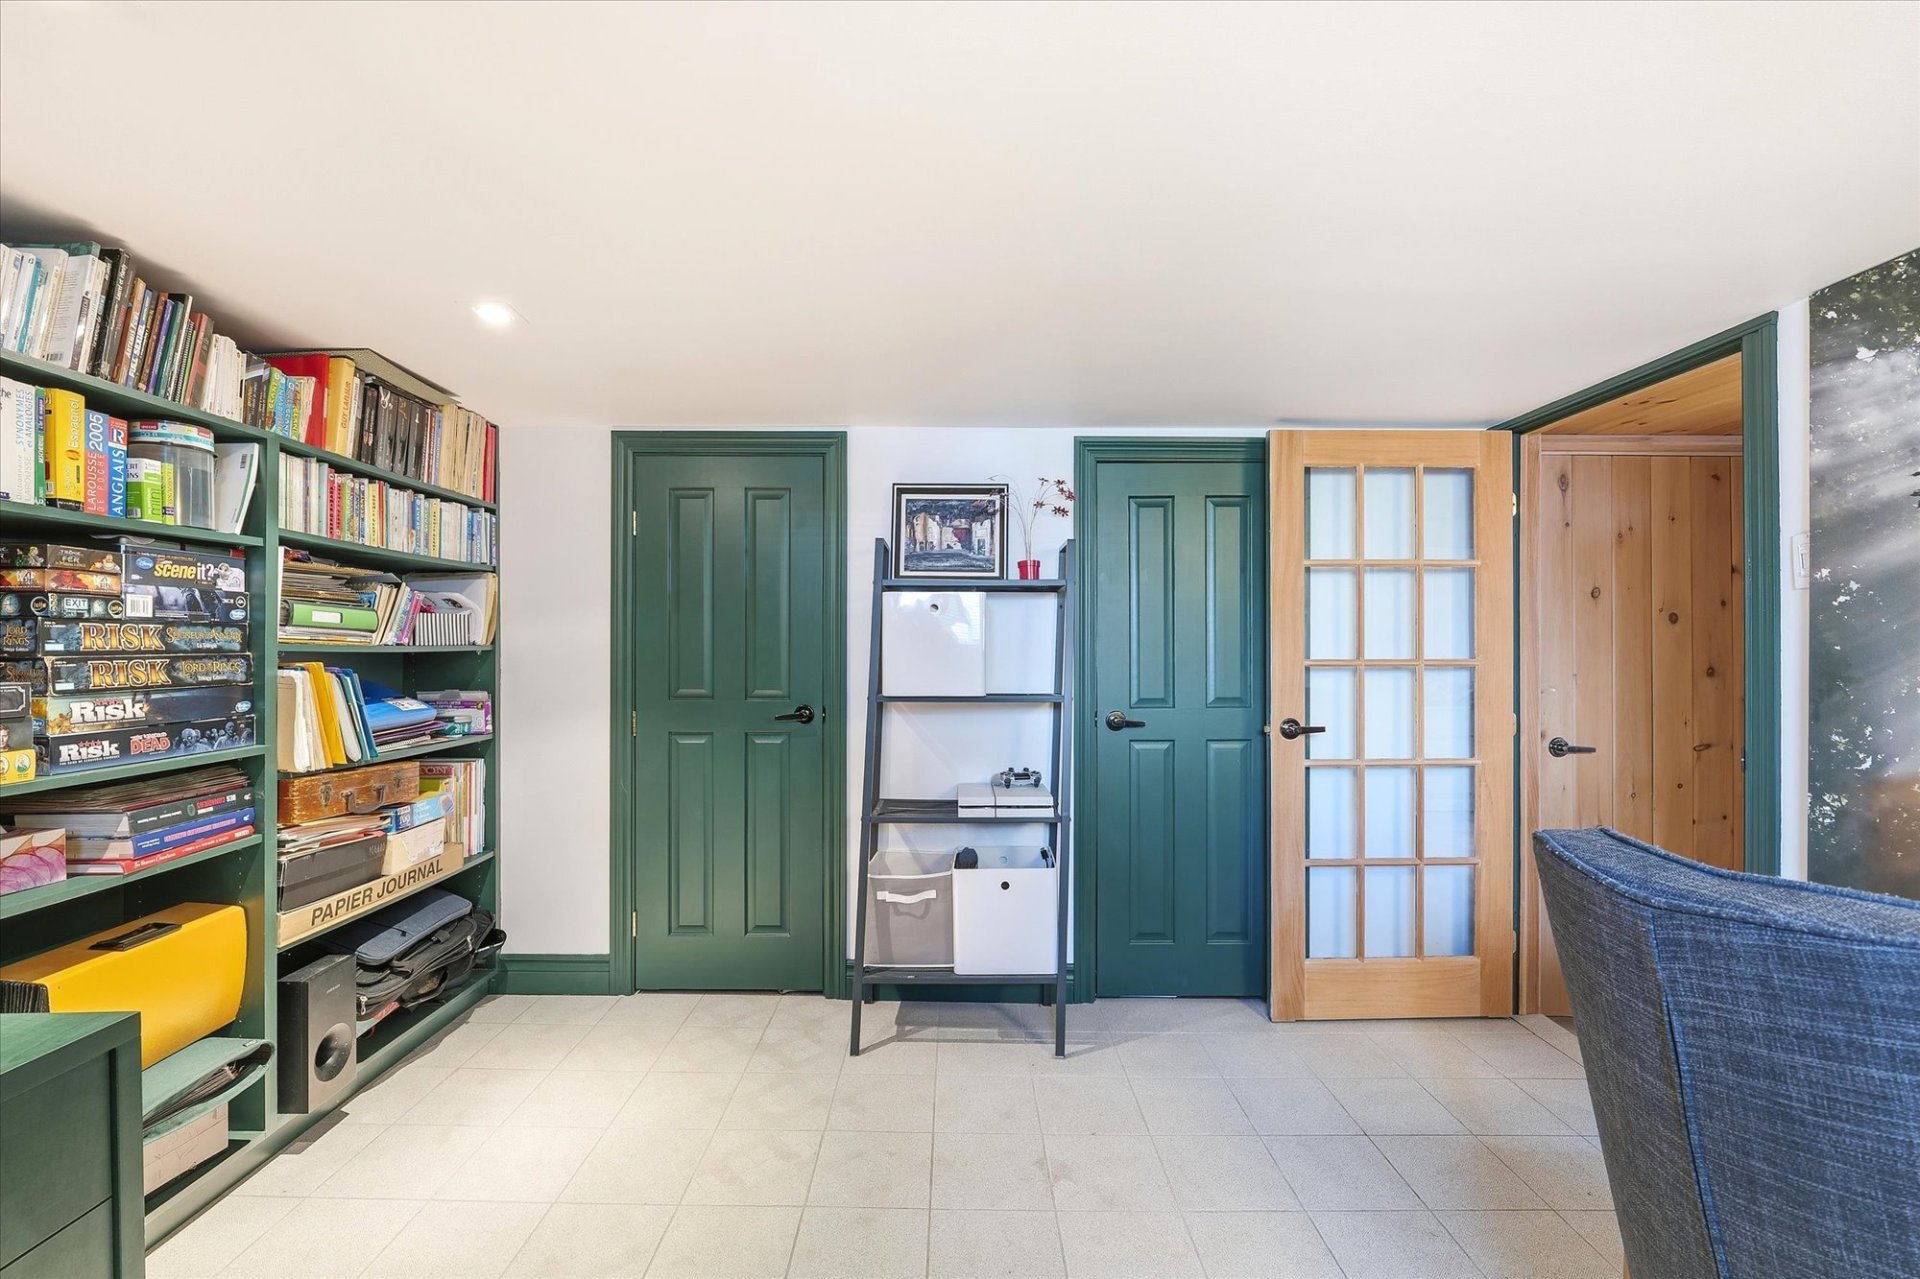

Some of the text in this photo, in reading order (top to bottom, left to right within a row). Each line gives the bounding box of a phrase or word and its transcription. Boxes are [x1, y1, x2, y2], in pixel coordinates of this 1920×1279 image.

[16, 388, 25, 447] SYNONYMES
[25, 390, 33, 440] ANALOGIES
[68, 400, 79, 448] Espagnol
[340, 412, 348, 429] GUY
[88, 413, 104, 511] LAROUSSE 2005
[112, 449, 125, 515] ANGLAIS
[97, 499, 104, 512] DE
[154, 562, 215, 580] scene it?
[65, 598, 88, 607] EXIT
[7, 624, 27, 635] LORD
[79, 623, 166, 652] RISK
[88, 659, 171, 689] RISK
[181, 661, 240, 676] LORD RINGS
[69, 699, 146, 724] Risk
[59, 740, 120, 762] Risk
[130, 737, 171, 755] DEAD
[311, 859, 444, 926] PAPIER JOURNAL
